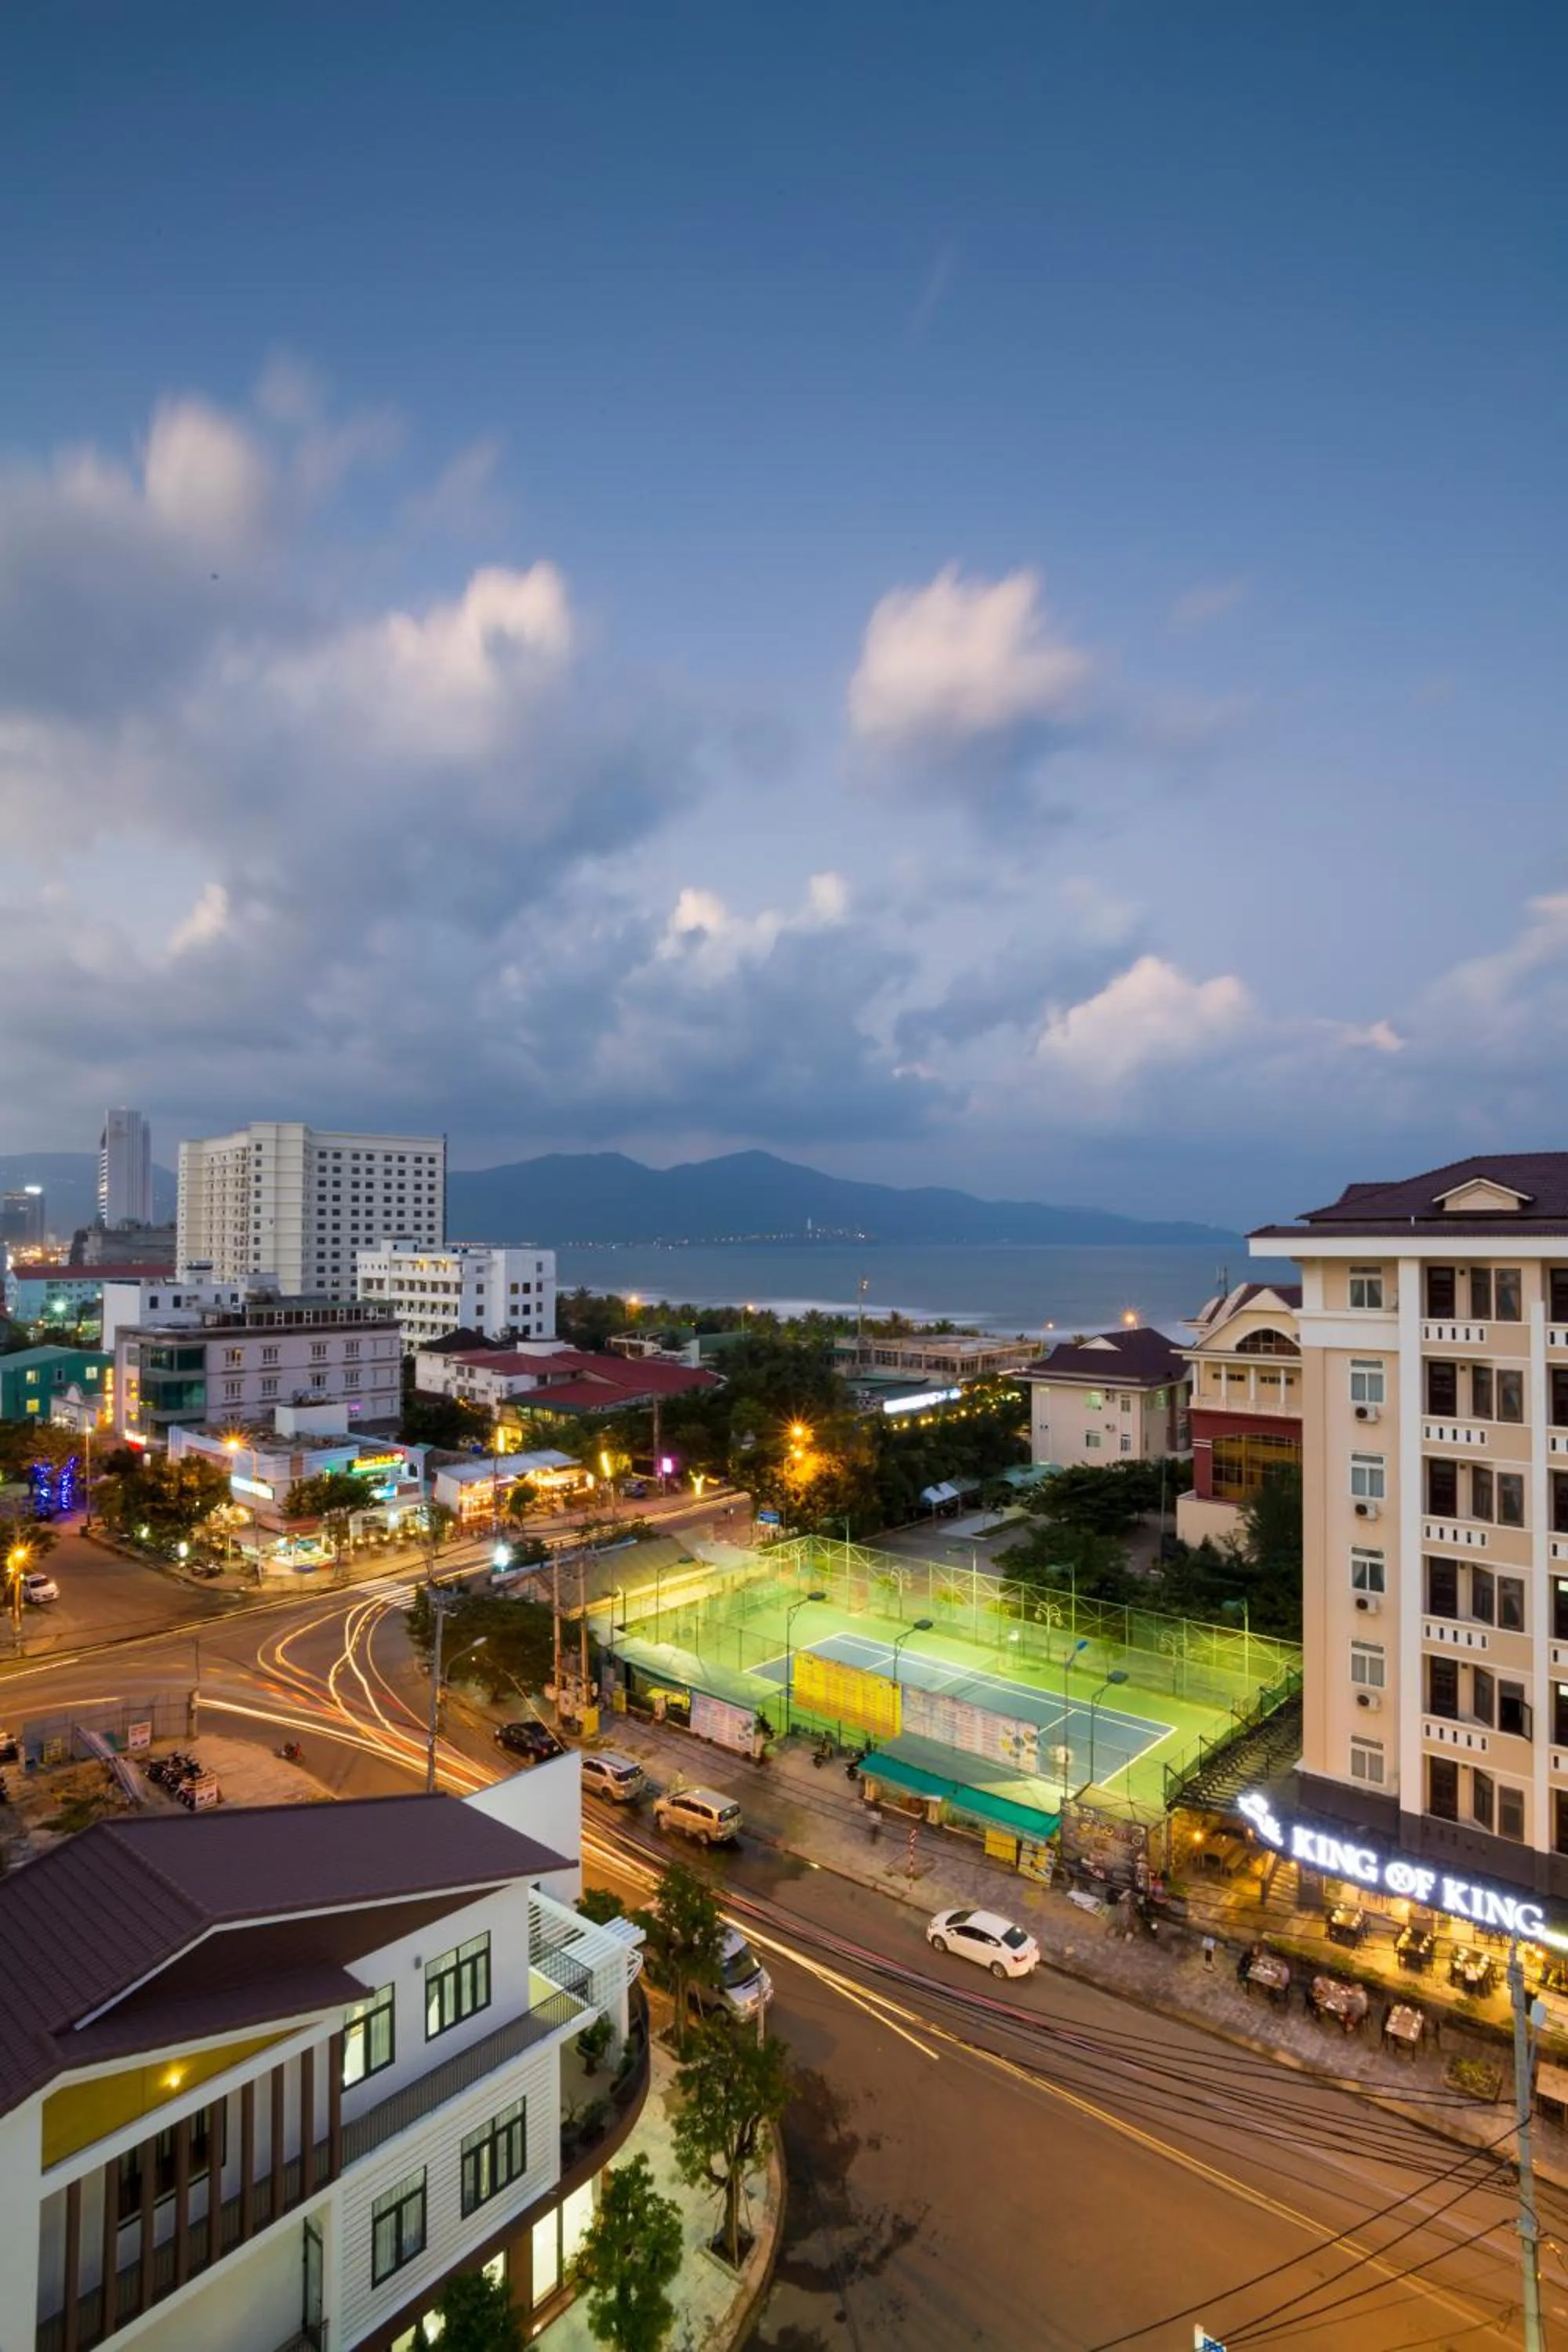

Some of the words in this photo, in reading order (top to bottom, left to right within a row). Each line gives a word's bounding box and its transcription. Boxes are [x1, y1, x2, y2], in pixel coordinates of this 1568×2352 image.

[1292, 1827, 1377, 1882] KING
[1385, 1862, 1436, 1900] OF
[1443, 1877, 1544, 1938] KING
